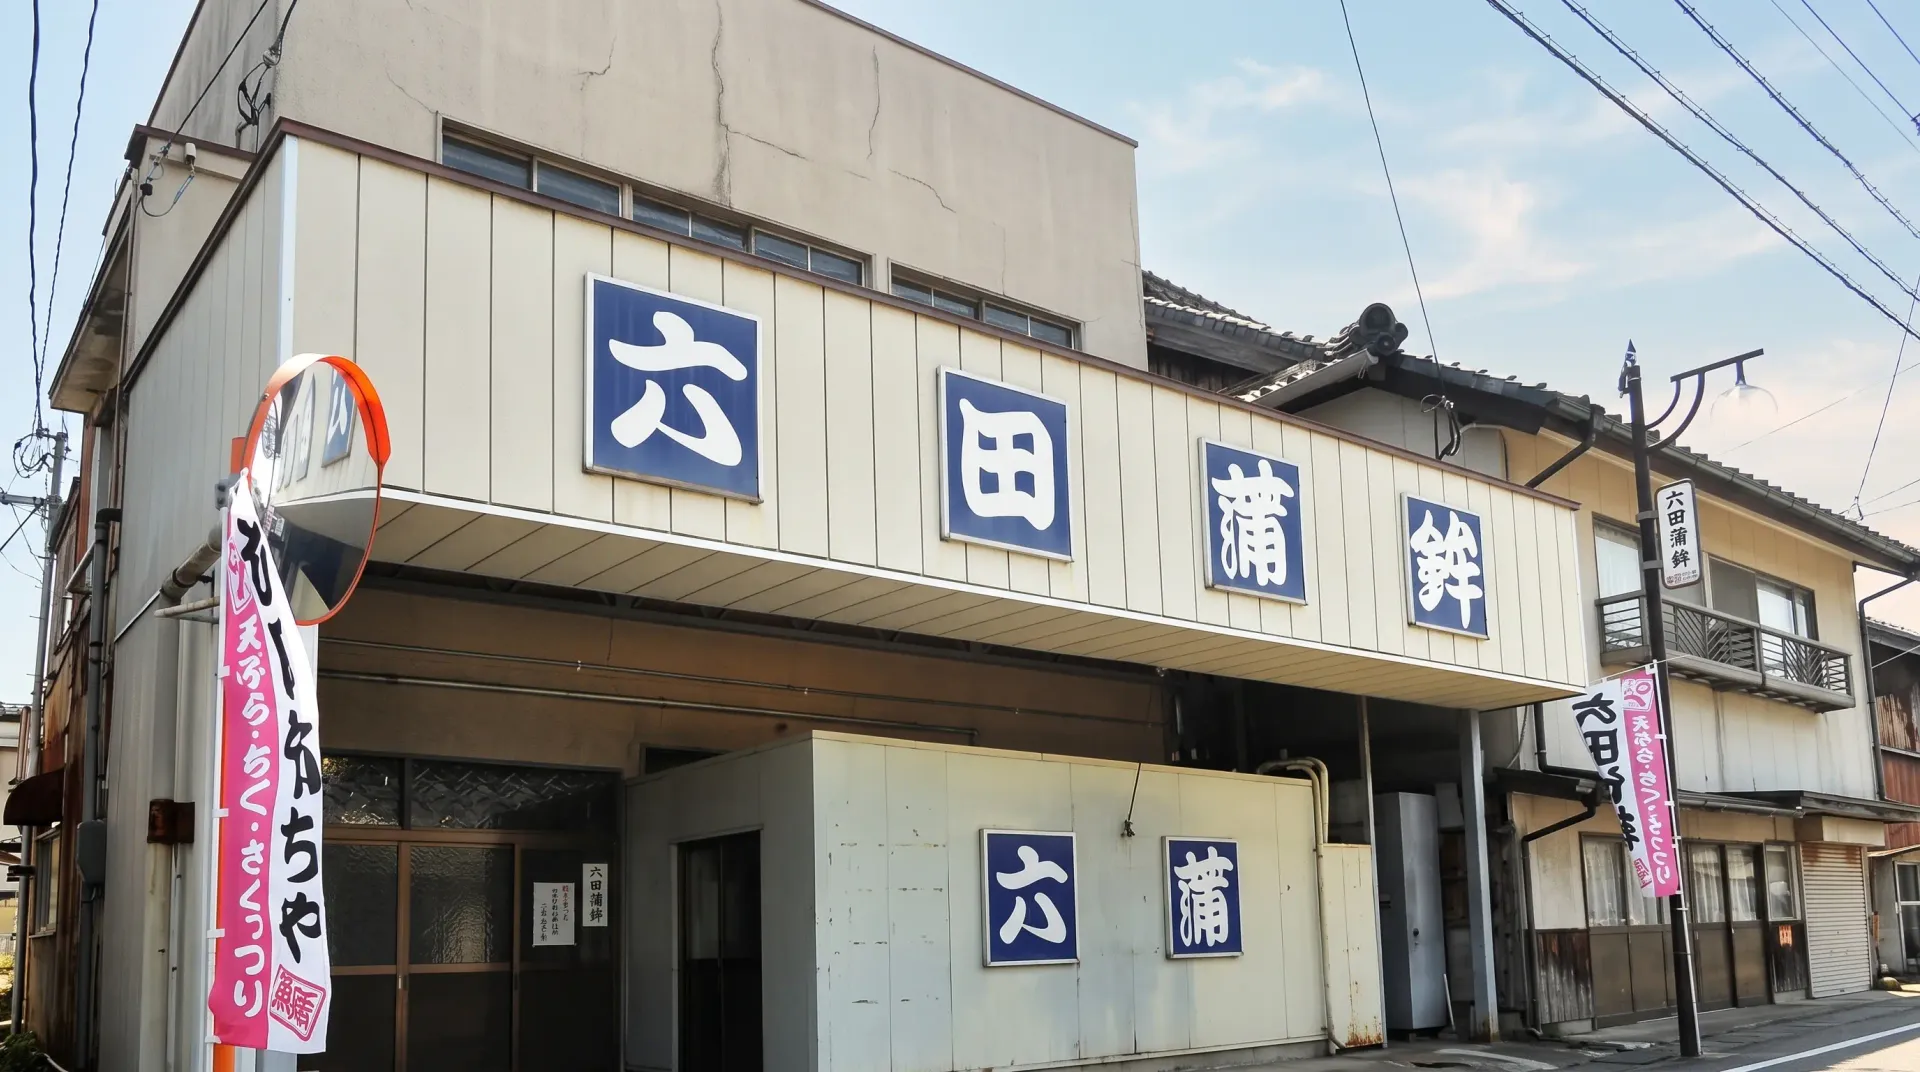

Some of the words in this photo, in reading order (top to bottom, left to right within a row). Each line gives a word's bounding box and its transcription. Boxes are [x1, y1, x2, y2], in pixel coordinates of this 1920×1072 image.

[608, 311, 748, 467] 六
[959, 398, 1055, 531] 田
[1211, 459, 1295, 586] 蒲
[1410, 510, 1483, 629] 鉾
[1666, 491, 1690, 569] 六田蒲鉾
[590, 866, 603, 923] 六田蒲鉾
[996, 845, 1068, 944] 六
[1174, 846, 1234, 947] 蒲
